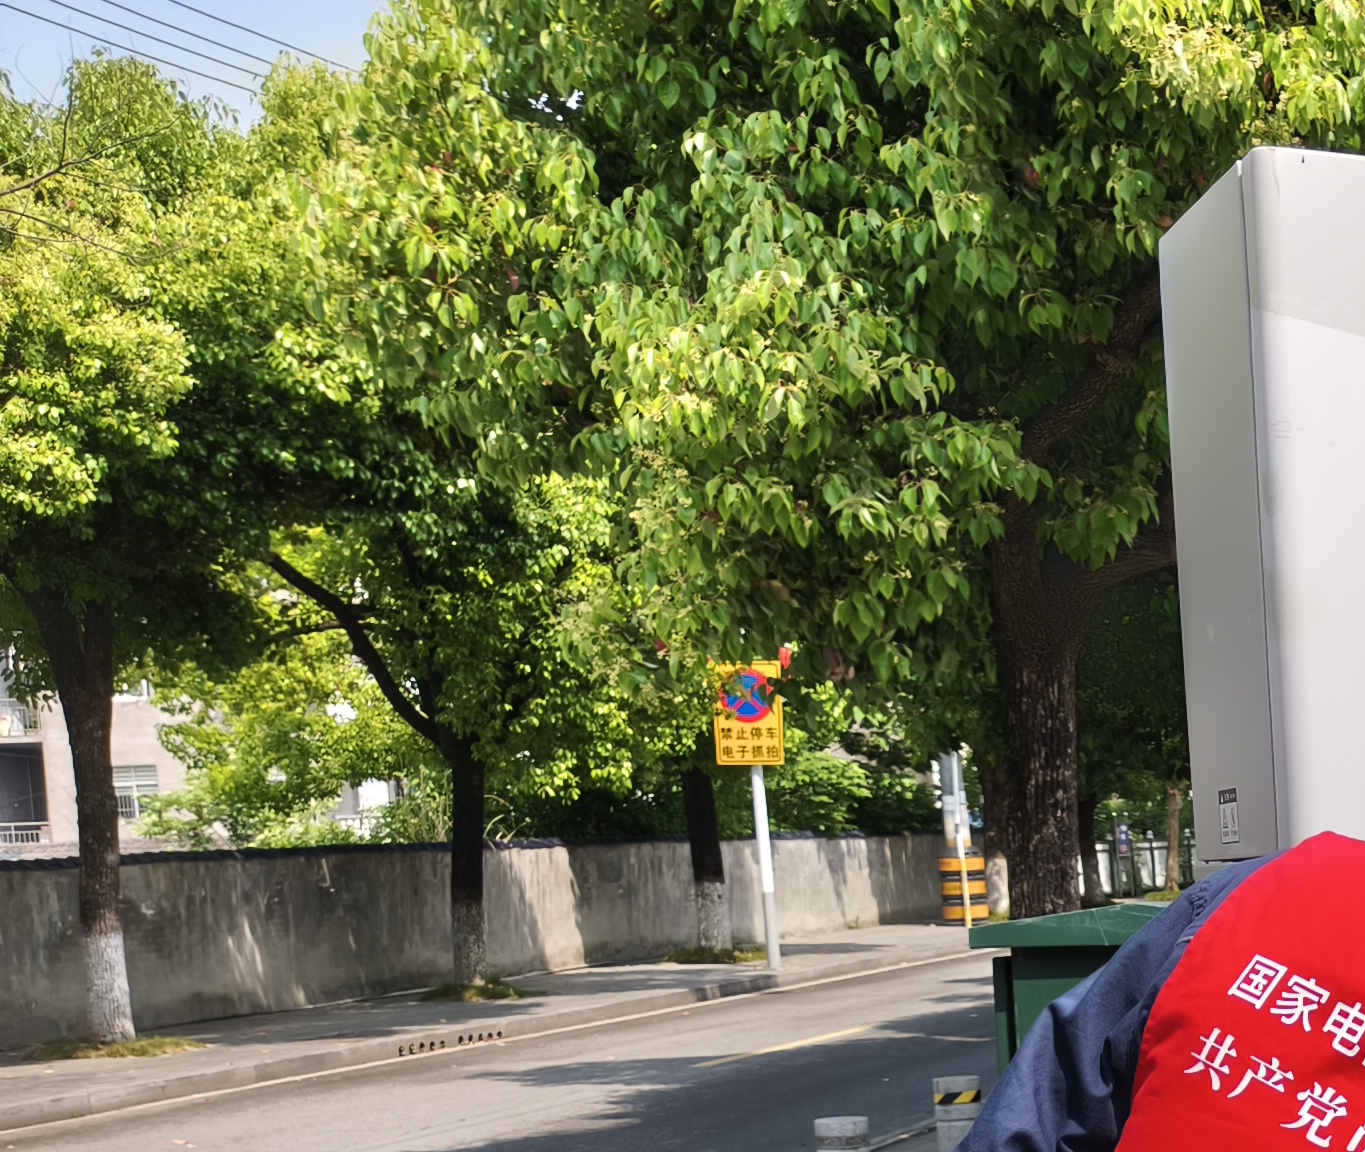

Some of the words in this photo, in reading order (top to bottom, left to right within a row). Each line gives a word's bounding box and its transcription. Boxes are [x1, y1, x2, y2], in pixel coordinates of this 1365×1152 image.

[721, 727, 778, 740] 禁止停车
[722, 745, 779, 759] 电子抓拍
